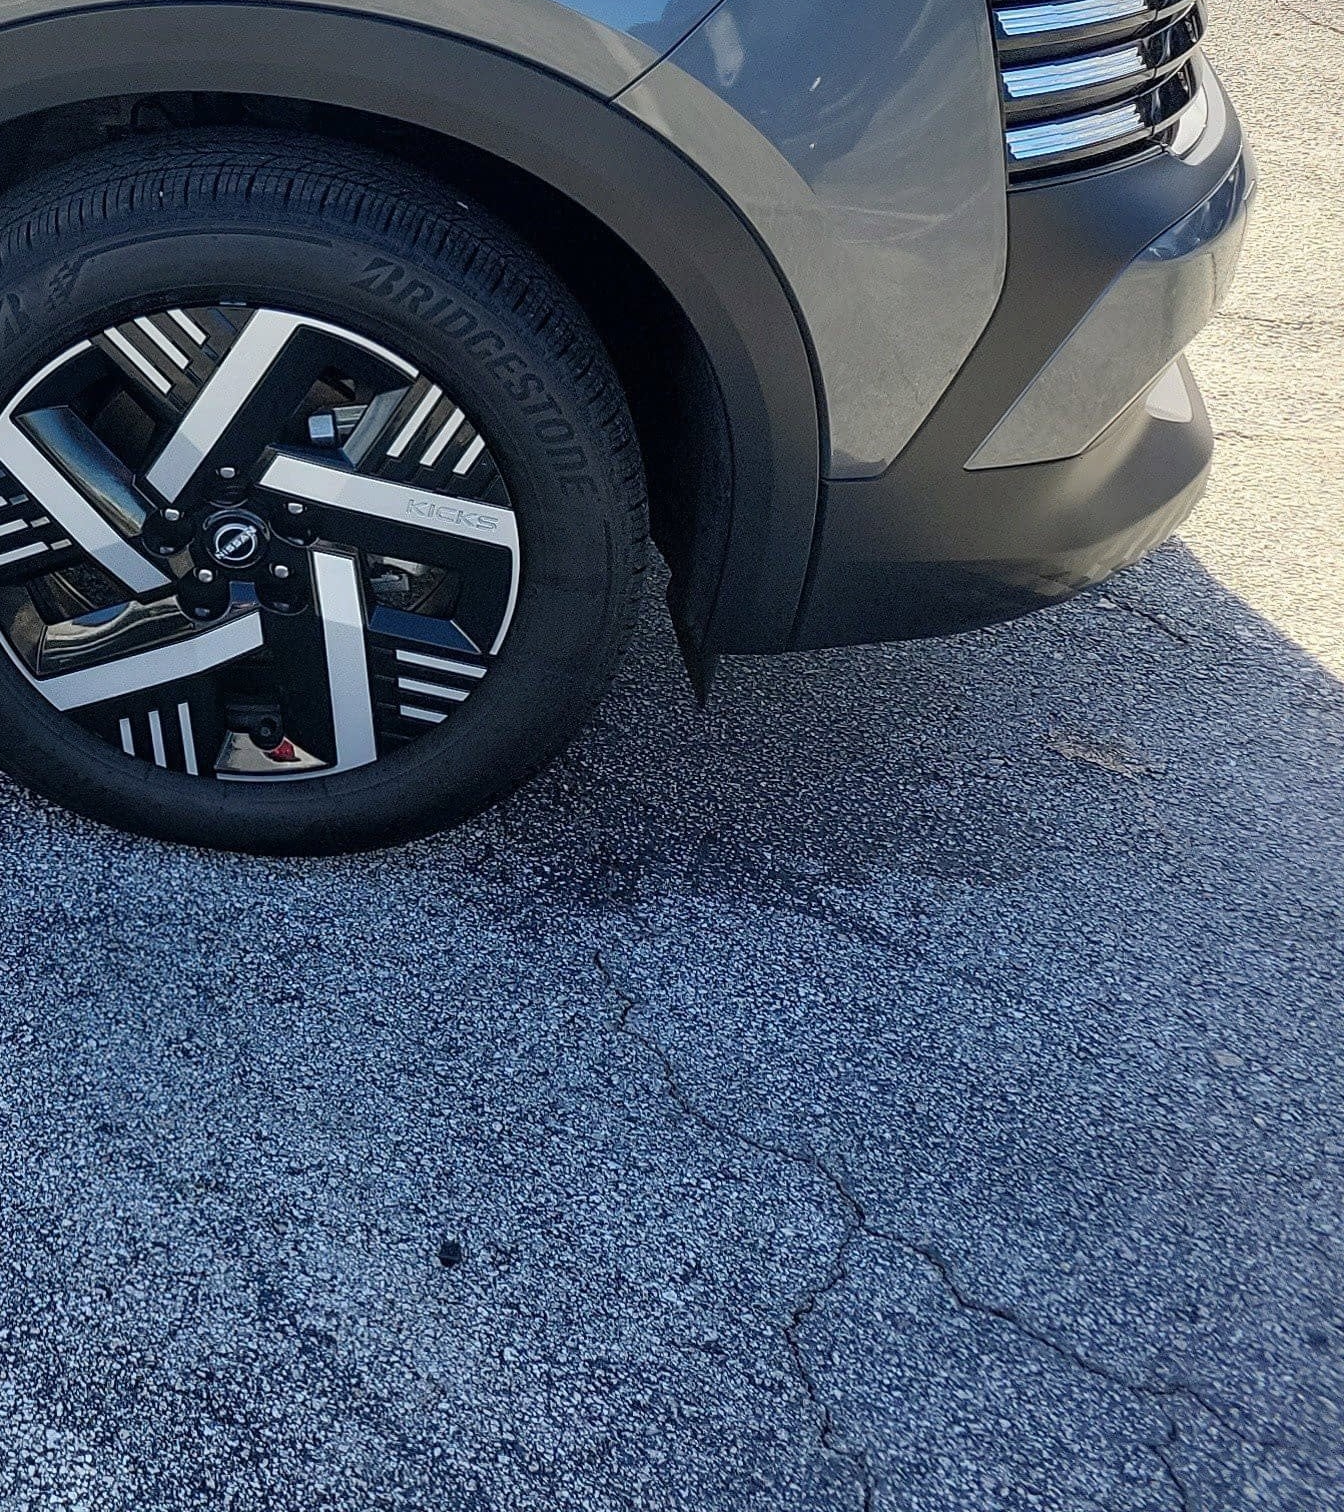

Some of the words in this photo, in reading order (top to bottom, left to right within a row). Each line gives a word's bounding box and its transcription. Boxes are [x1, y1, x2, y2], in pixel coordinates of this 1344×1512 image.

[350, 256, 599, 498] BRIDGESTONE
[406, 498, 499, 530] KICKS
[215, 525, 257, 560] NISSAN
